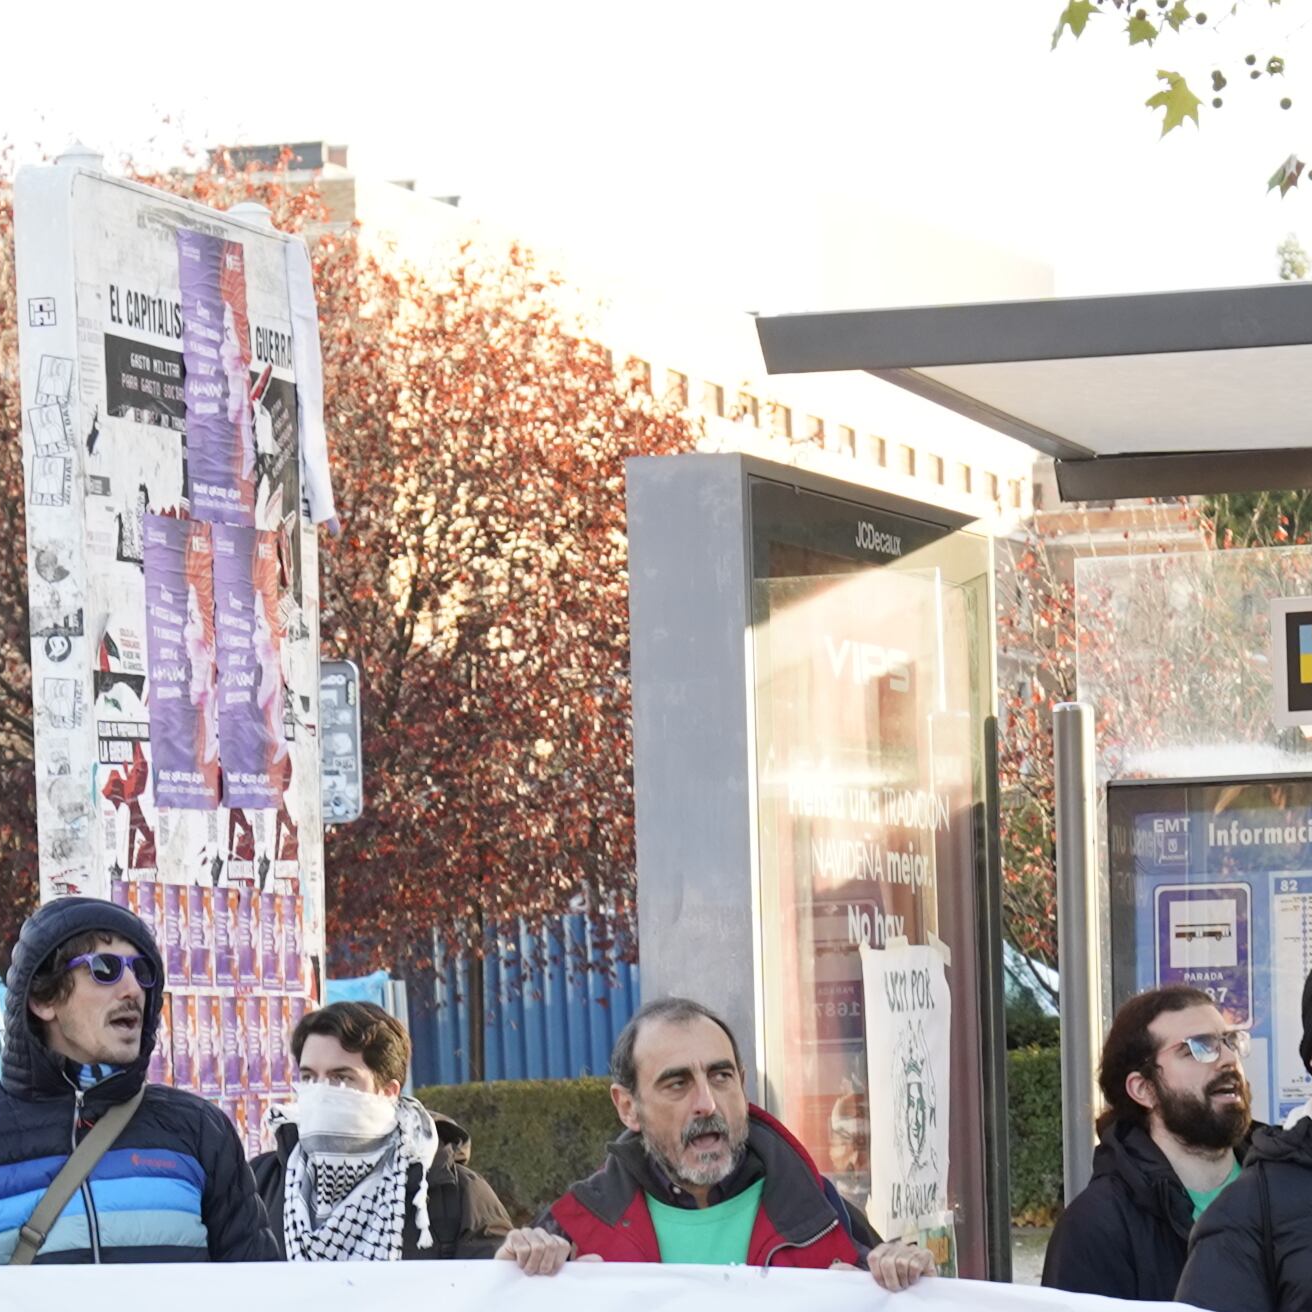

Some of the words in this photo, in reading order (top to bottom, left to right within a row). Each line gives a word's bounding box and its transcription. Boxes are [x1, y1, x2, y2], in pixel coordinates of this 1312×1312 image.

[109, 284, 122, 323] EL
[126, 290, 182, 339] CAPITALIS
[255, 326, 293, 370] GUERRA
[153, 357, 181, 377] MILITAR
[163, 382, 184, 400] SOCIA
[855, 521, 902, 556] JCDecaux
[823, 637, 910, 692] VIPS
[849, 789, 882, 823] una
[1153, 818, 1191, 833] EMT
[811, 832, 885, 882] NAVIDEÑA
[886, 841, 933, 895] mejor.
[1280, 880, 1298, 892] 82
[848, 904, 870, 945] No
[873, 905, 904, 945] hay
[911, 967, 934, 1011] POR
[1184, 972, 1224, 982] PARADA
[891, 1182, 903, 1219] LA
